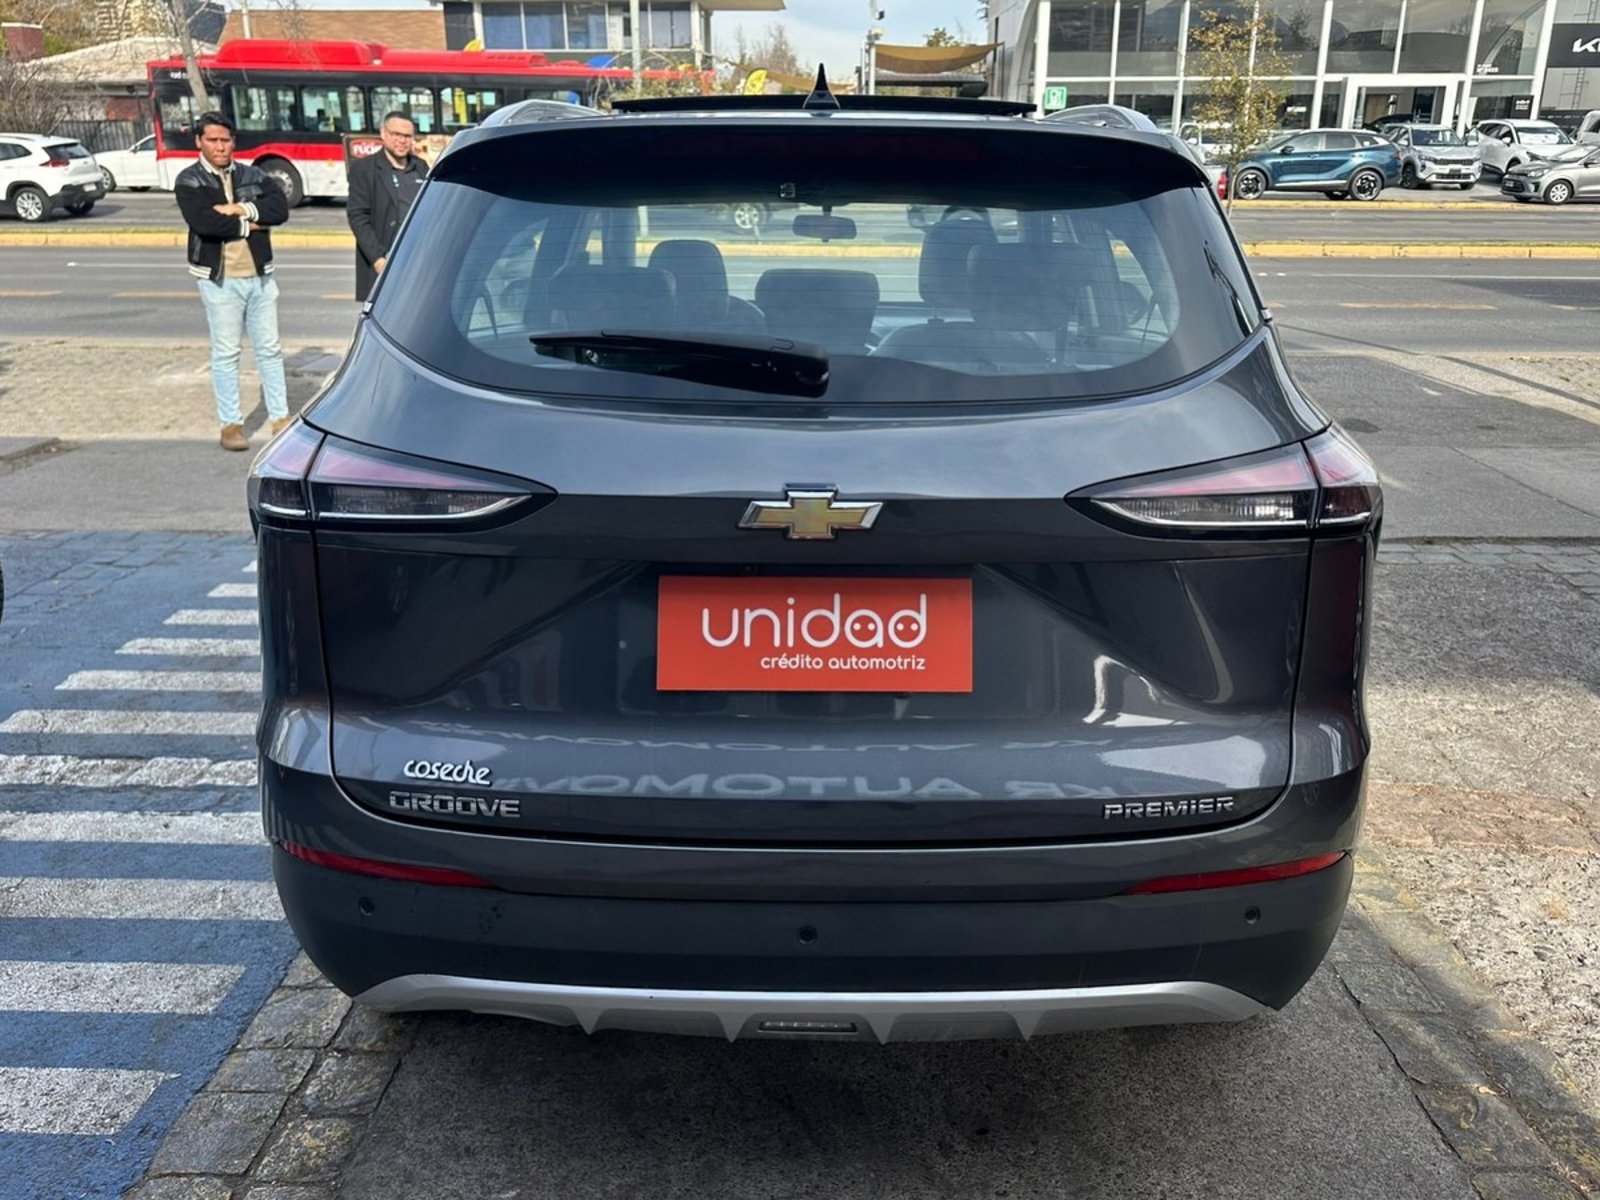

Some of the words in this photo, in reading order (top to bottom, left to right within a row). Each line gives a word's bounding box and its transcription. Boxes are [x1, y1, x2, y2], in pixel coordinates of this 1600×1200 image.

[702, 593, 927, 649] unidad
[760, 653, 823, 670] crédito
[828, 654, 926, 670] automotriz
[403, 759, 491, 785] coseche
[389, 790, 520, 818] GROOVE
[1104, 796, 1234, 820] PREMIER
